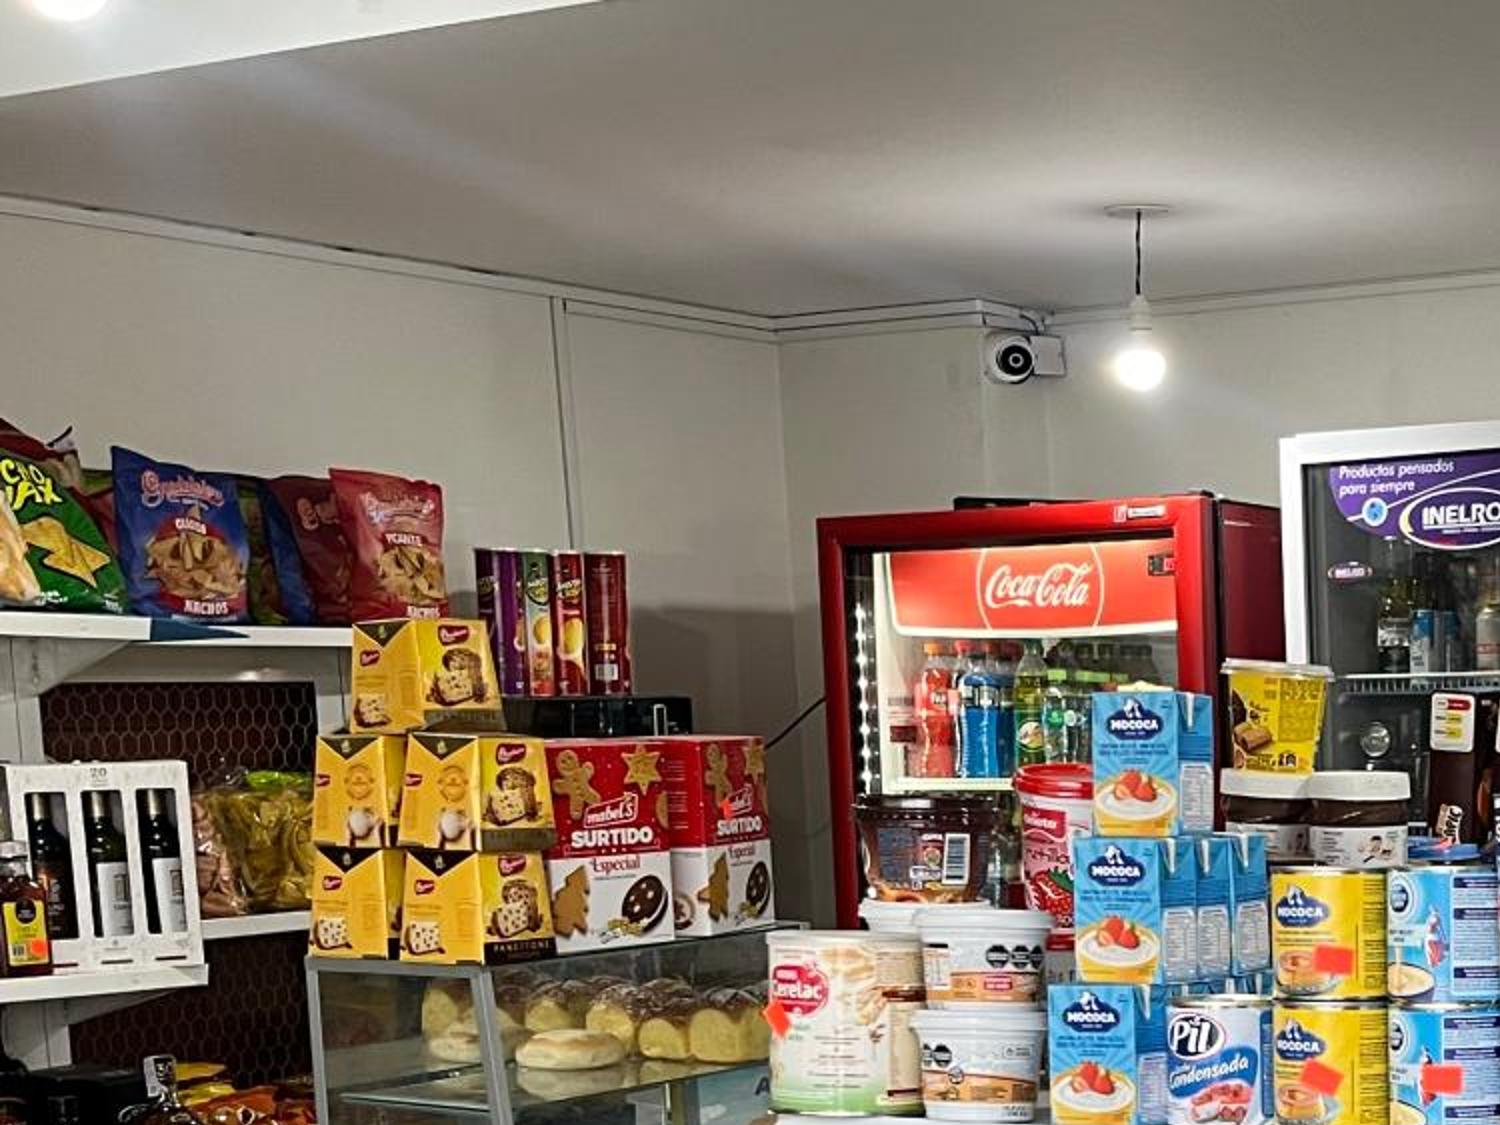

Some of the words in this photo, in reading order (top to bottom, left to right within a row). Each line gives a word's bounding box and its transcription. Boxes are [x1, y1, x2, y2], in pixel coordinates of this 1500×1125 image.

[1338, 464, 1395, 480] Productos
[1398, 458, 1454, 479] pensados
[1338, 484, 1367, 499] para
[1370, 480, 1416, 497] siempre
[984, 563, 1093, 609] Coca-Cola
[1110, 718, 1159, 731] MOCOCA
[570, 825, 654, 849] SURTIDO
[716, 815, 763, 837] SURTIDO
[1091, 865, 1141, 878] MOCOCA
[1066, 1011, 1117, 1024] MOCOCA
[1172, 1017, 1211, 1054] Pil
